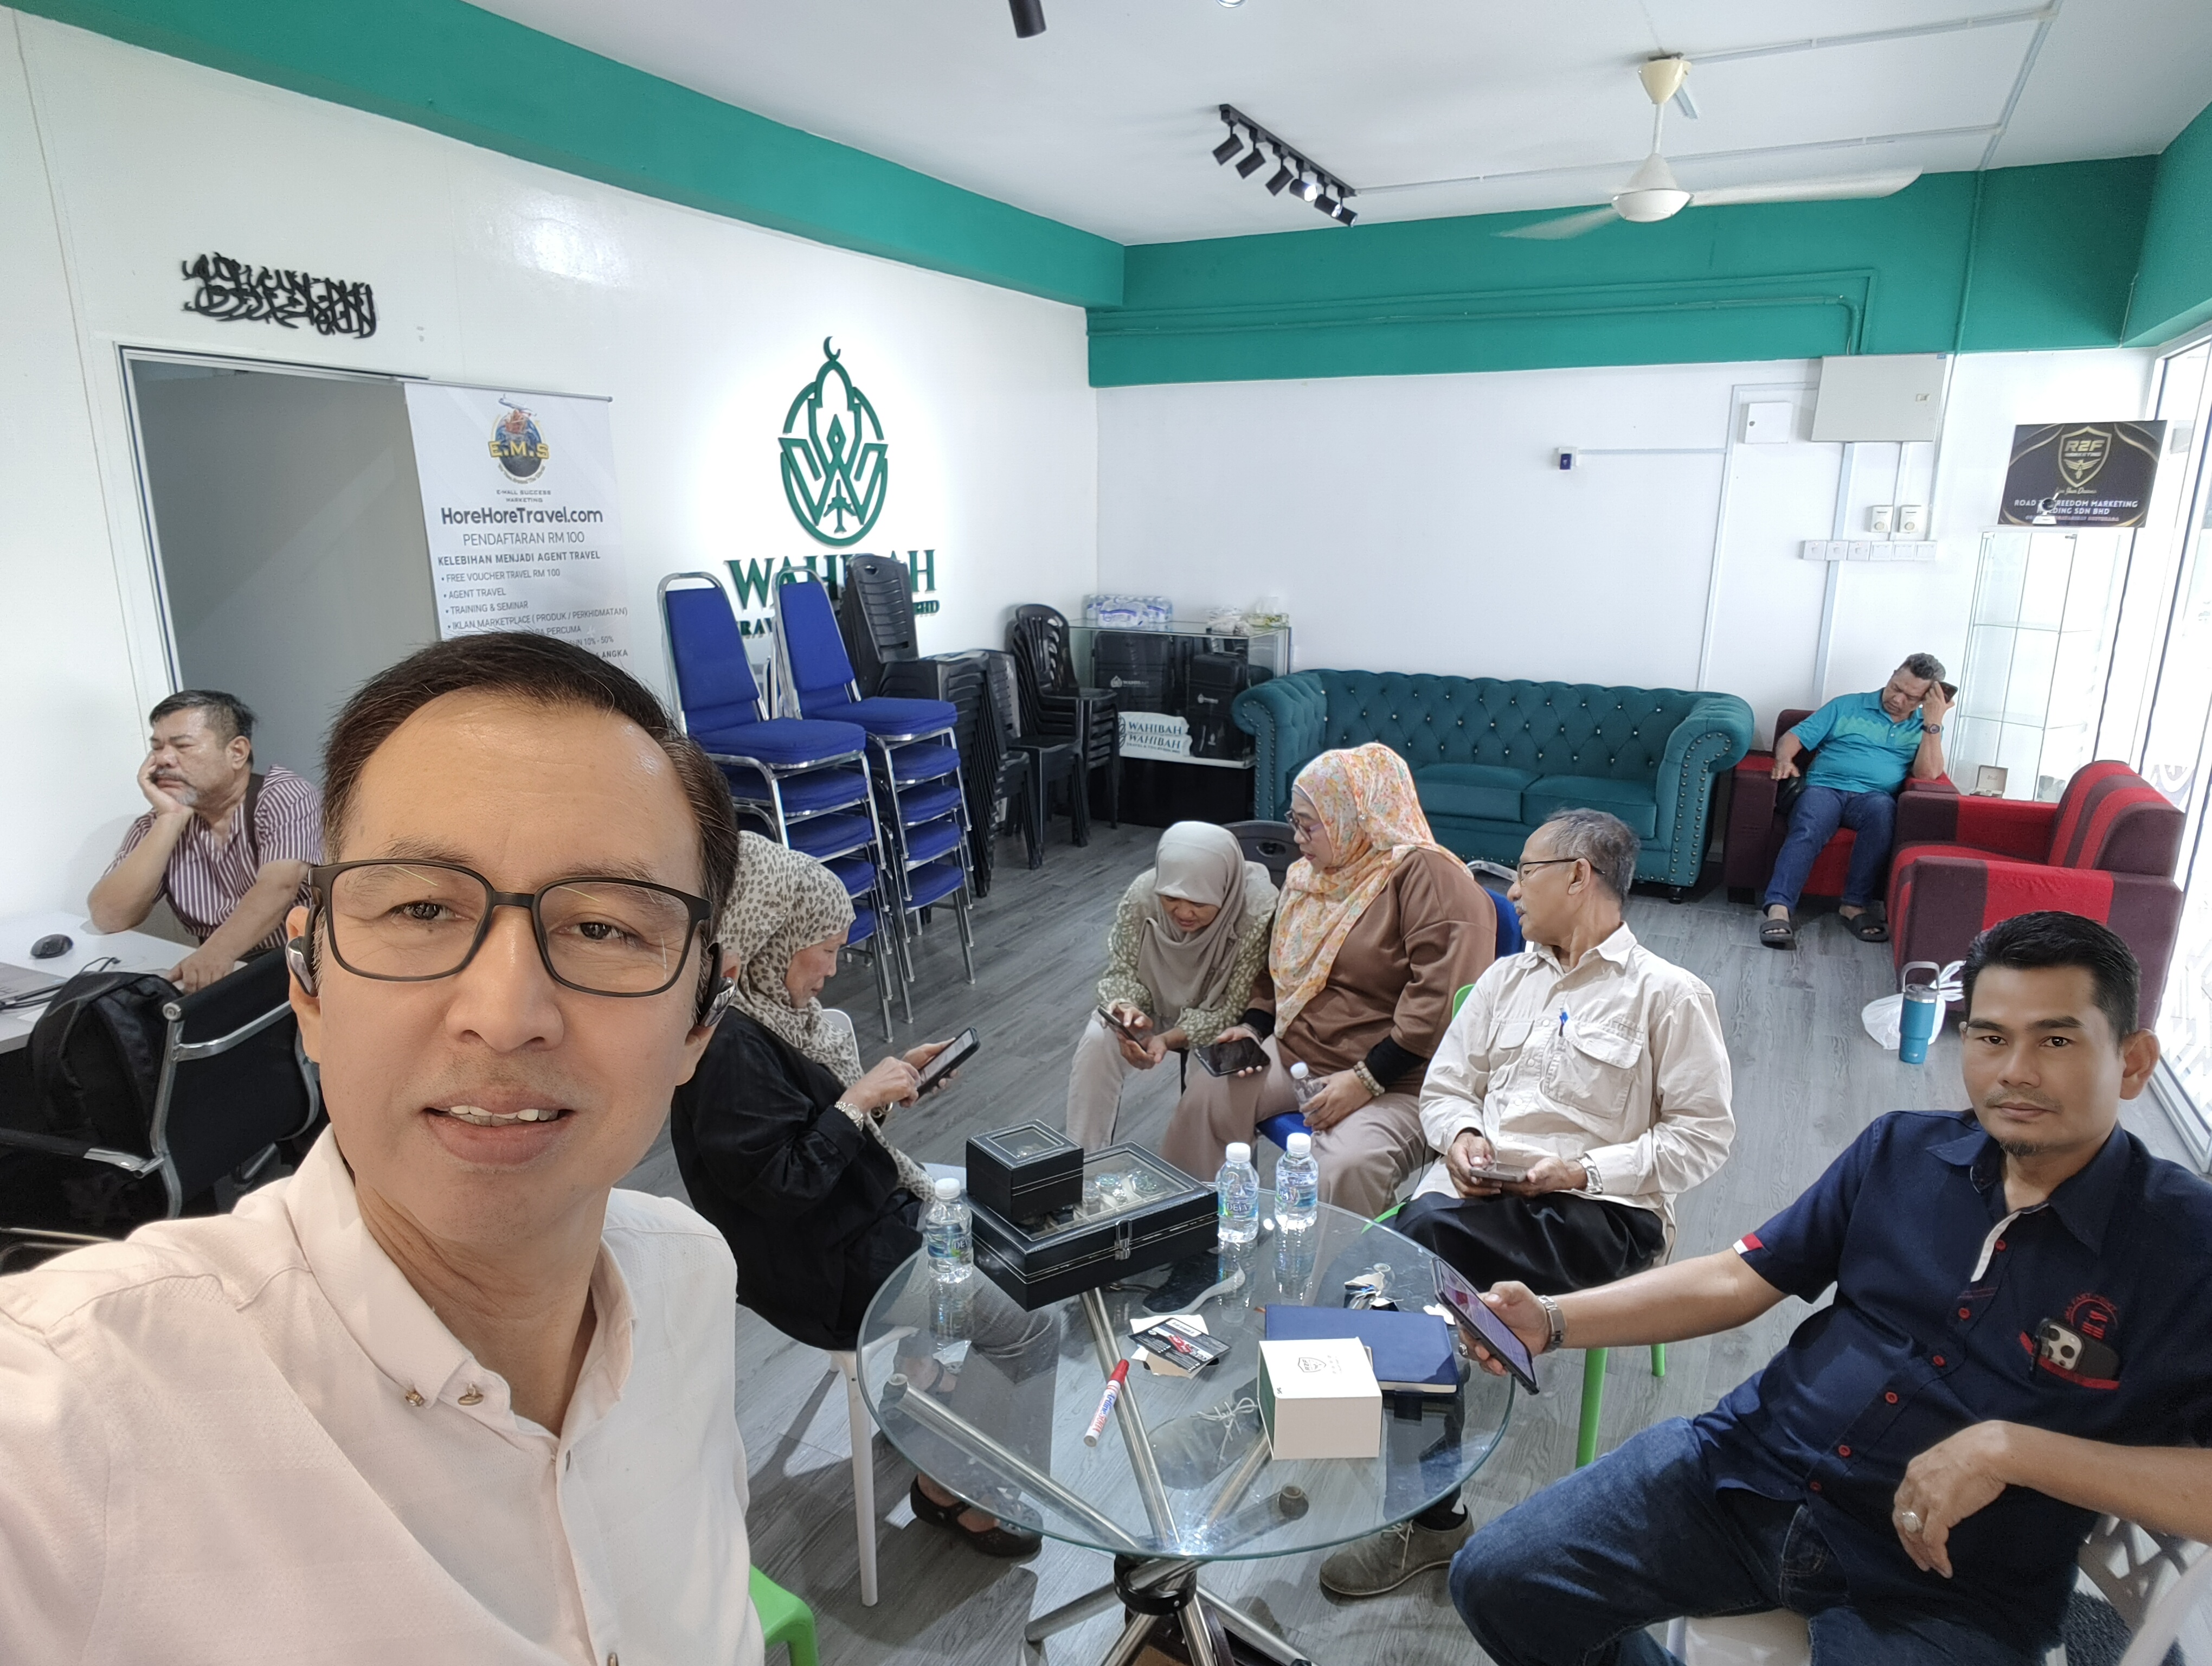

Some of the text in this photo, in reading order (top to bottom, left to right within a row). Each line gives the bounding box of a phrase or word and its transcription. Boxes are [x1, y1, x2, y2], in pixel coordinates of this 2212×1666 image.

[488, 441, 549, 459] E.M.S
[2065, 440, 2105, 451] R2F
[441, 507, 603, 525] HoreHoreTravel.com
[463, 531, 584, 546] PENDAFTARAN RM 100
[438, 551, 601, 566] KELEBIHAN MENJADI AGENT TRAVEL
[446, 568, 560, 582] FREE VOUCHER TRAVEL RM 100
[449, 587, 506, 599] AGENT TRAVEL
[451, 604, 487, 614] TRAINING
[497, 601, 529, 611] SEMINAR
[453, 620, 475, 630] IKLAN
[477, 615, 530, 627] MARKETPLACE
[572, 607, 628, 619] PERKHIDMATAN)
[546, 625, 581, 635] PERCUMA
[584, 637, 596, 645] 10%
[601, 636, 614, 644] 50%
[602, 650, 628, 658] ANGKA
[1129, 722, 1181, 734] WAHIBAH
[1129, 734, 1180, 749] WAHIBAH
